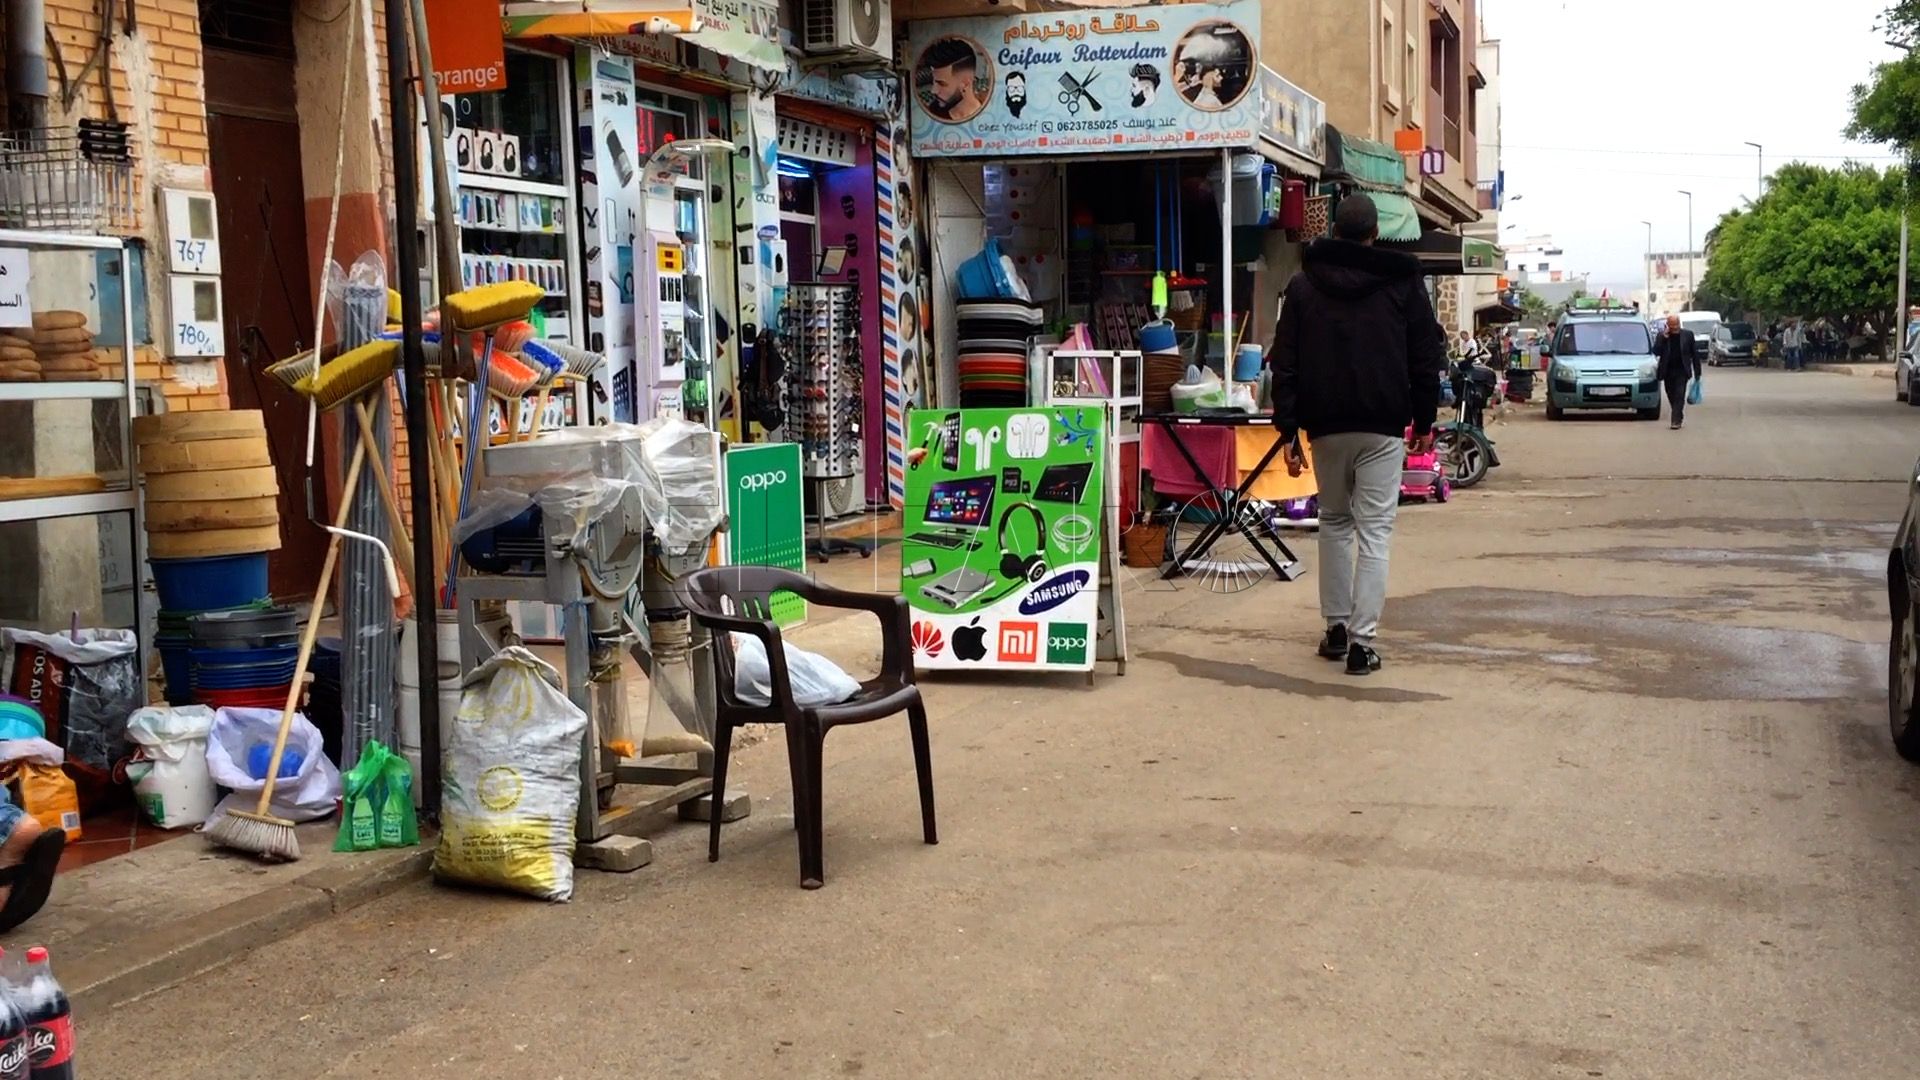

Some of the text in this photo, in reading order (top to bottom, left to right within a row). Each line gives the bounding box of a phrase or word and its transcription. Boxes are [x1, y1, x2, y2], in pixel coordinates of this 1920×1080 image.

[1004, 13, 1159, 43] حلاقة روتردام
[998, 42, 1167, 69] Coifour Rotterdam
[432, 66, 498, 88] orange
[1057, 119, 1118, 132] 0623785025
[175, 239, 206, 264] 767
[740, 470, 787, 492] oppo
[1026, 579, 1083, 606] SAMSUNG
[1047, 636, 1087, 651] oppo
